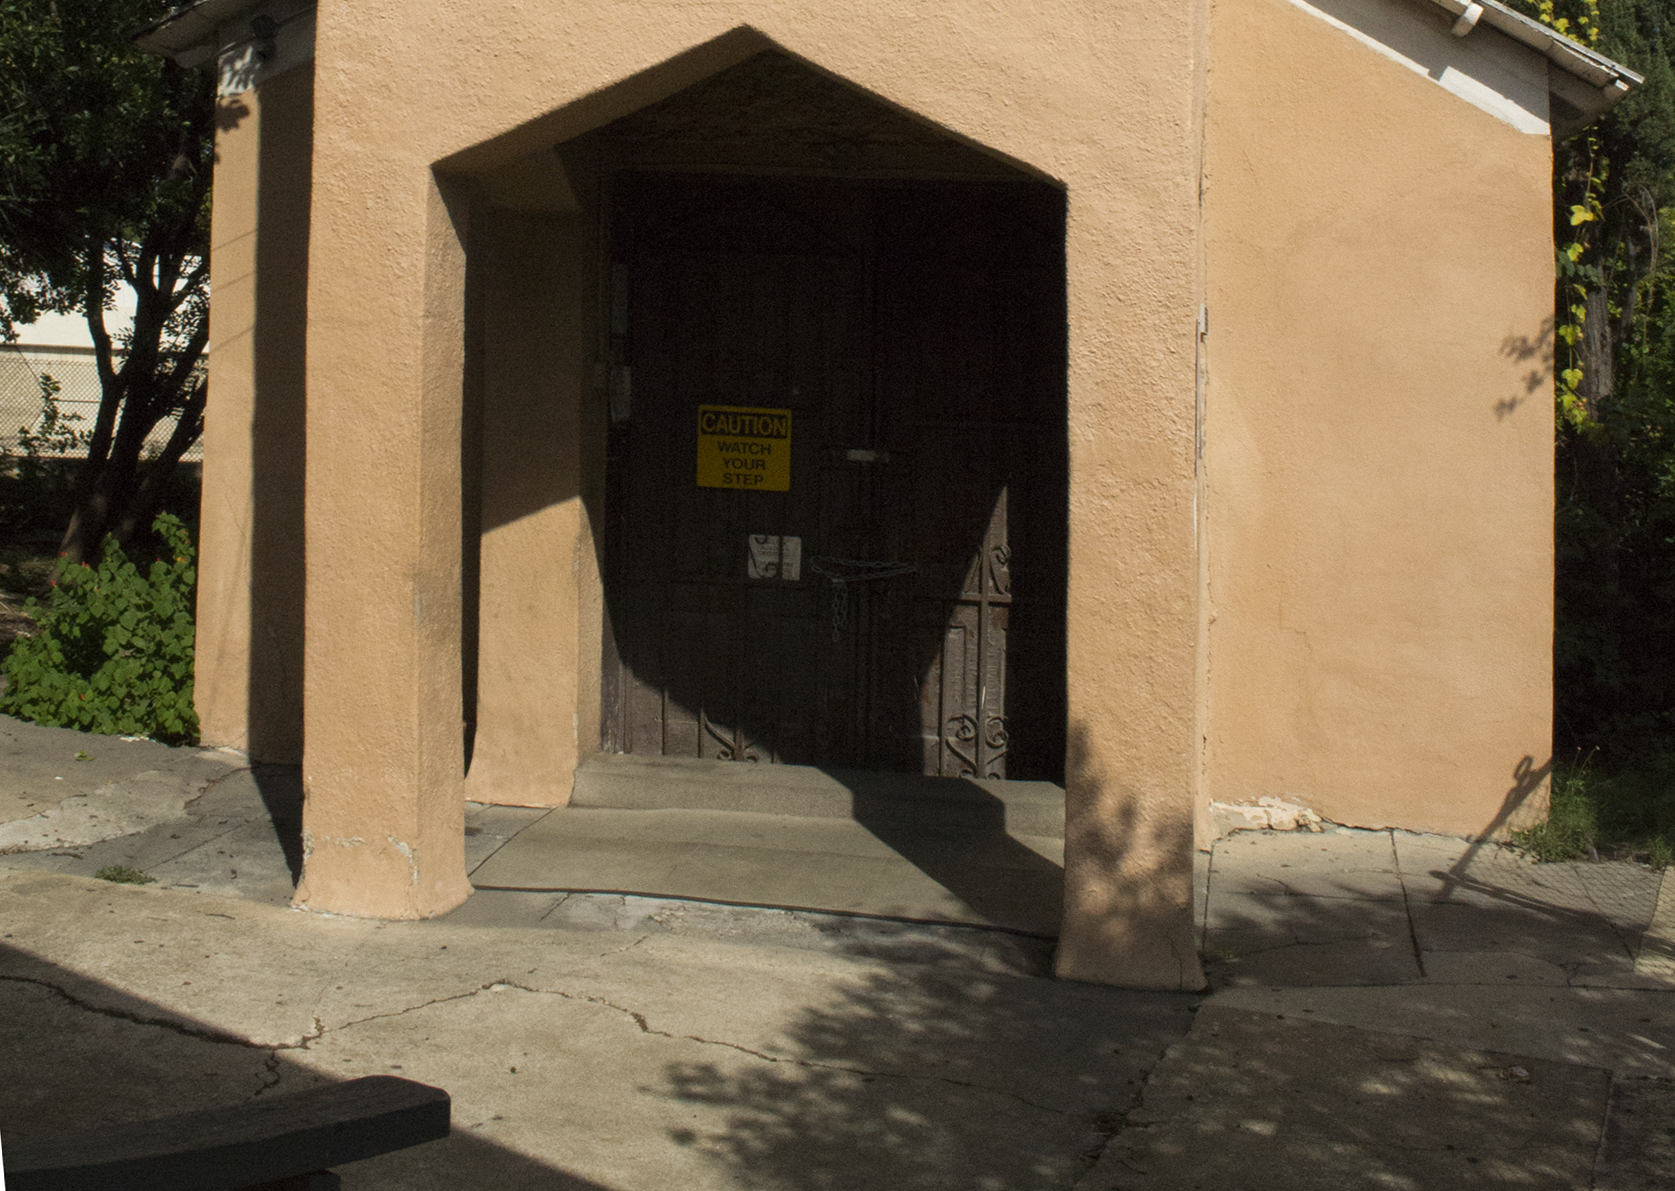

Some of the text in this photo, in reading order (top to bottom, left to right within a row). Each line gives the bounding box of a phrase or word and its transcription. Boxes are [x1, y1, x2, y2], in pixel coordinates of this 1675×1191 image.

[702, 412, 786, 436] CAUTION
[717, 440, 772, 455] WATCH
[721, 457, 766, 471] YOUR
[722, 472, 764, 486] STEP
